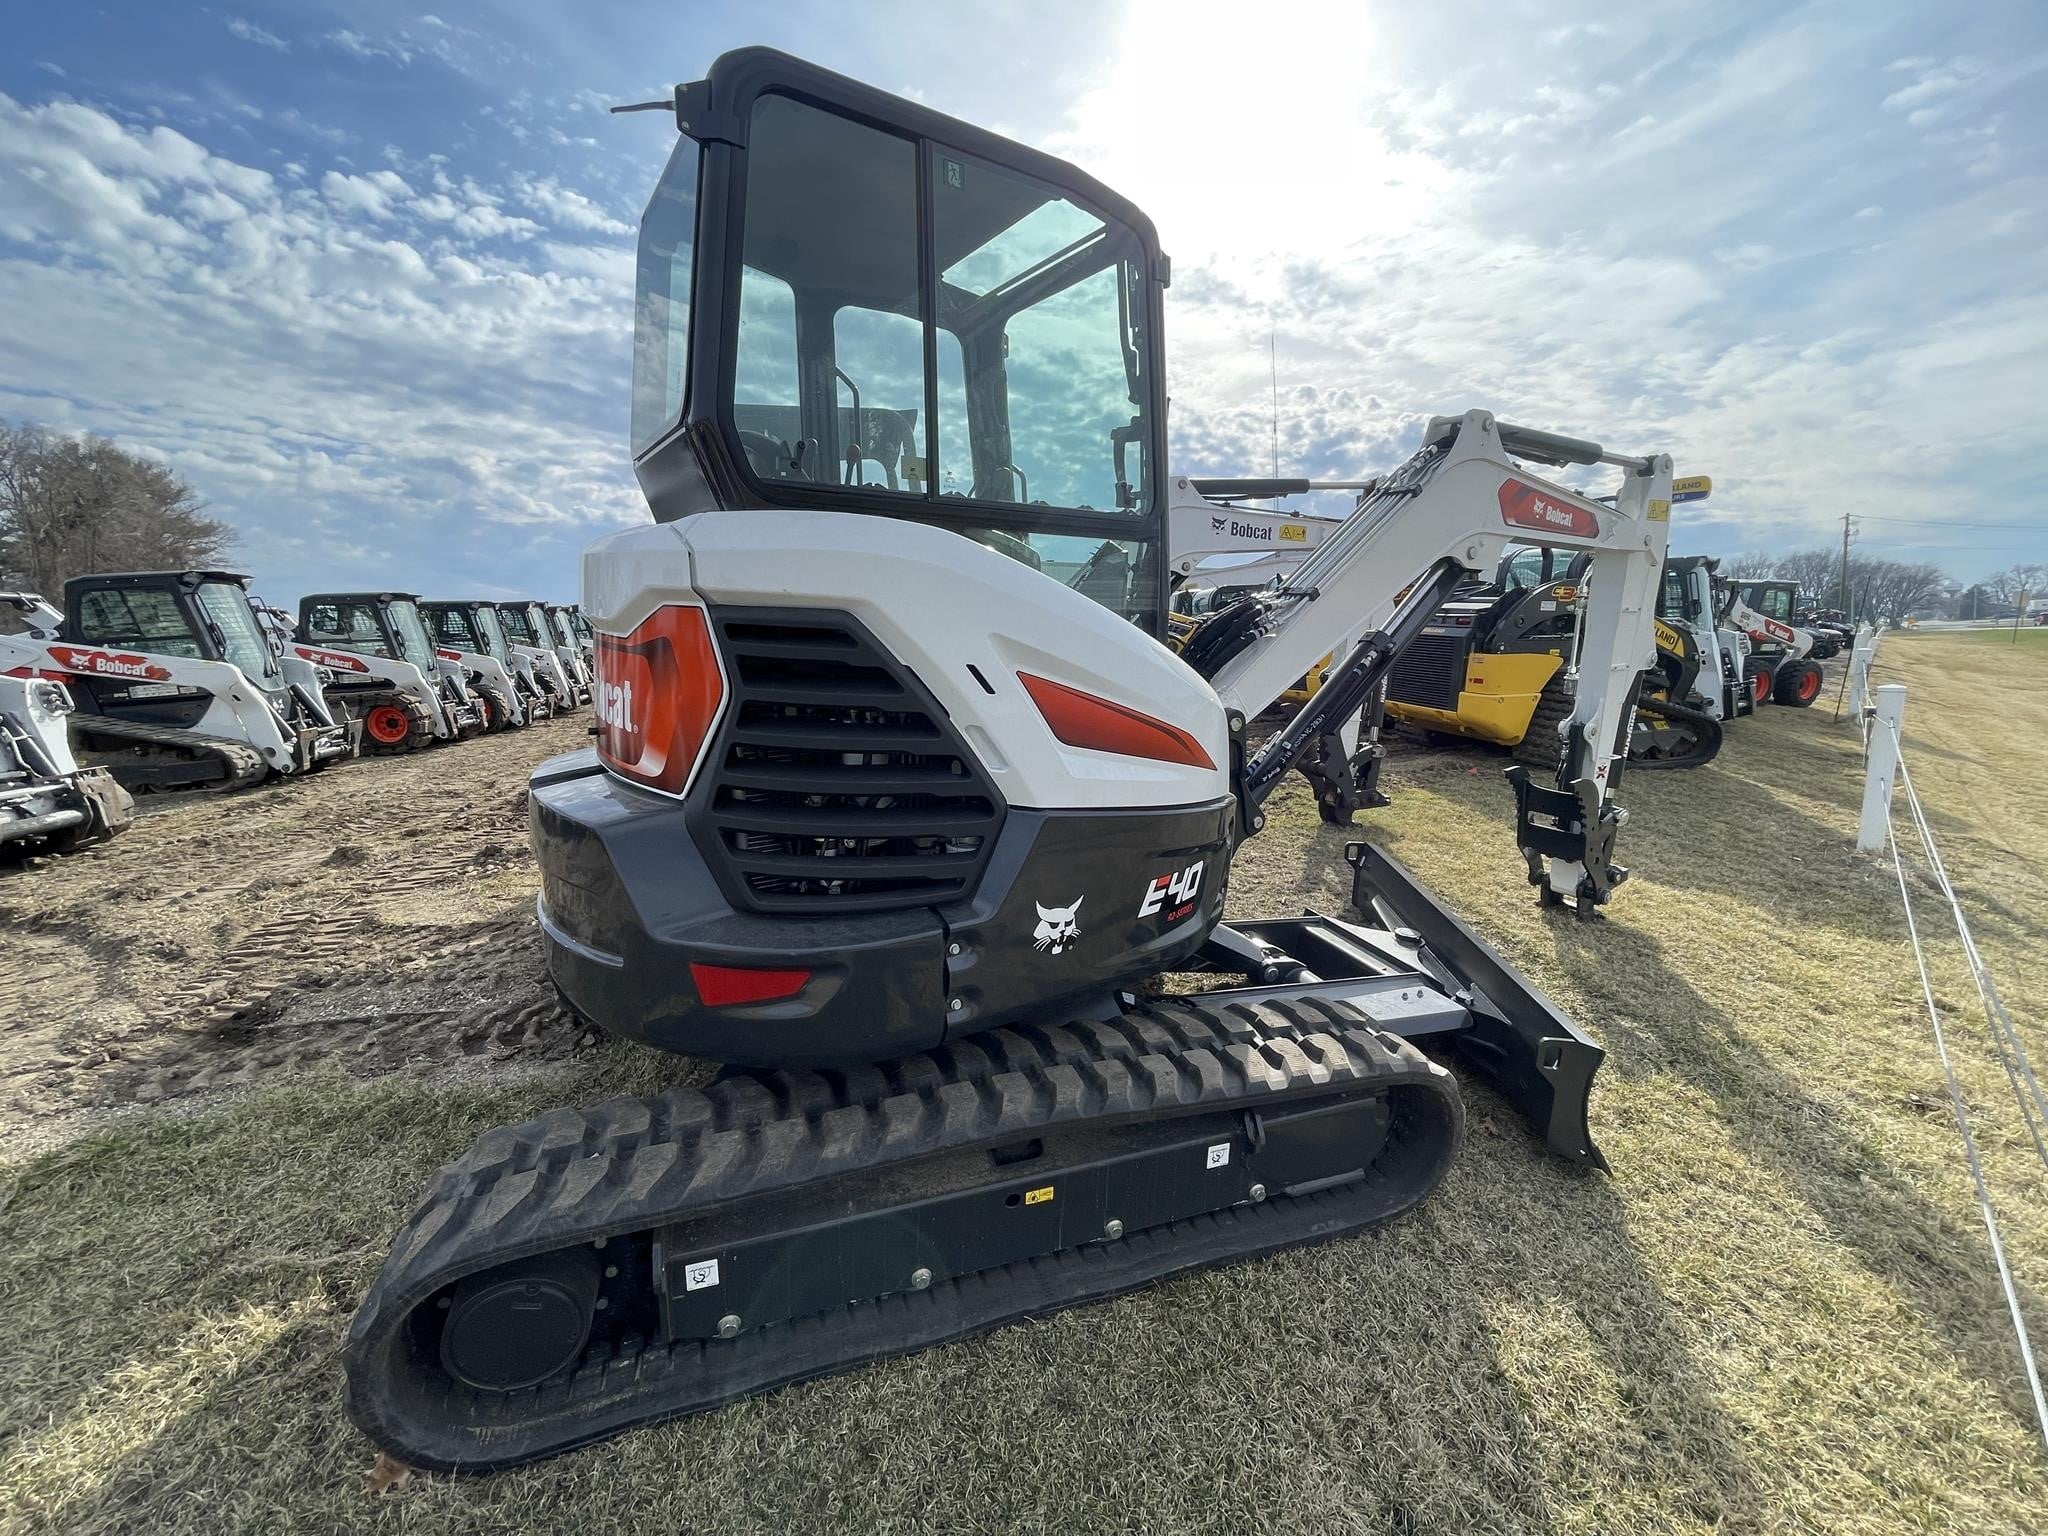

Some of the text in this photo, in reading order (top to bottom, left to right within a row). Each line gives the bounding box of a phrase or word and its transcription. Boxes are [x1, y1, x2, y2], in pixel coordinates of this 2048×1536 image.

[1546, 506, 1573, 527] Bobcat
[1231, 521, 1272, 540] Bobcat
[96, 658, 147, 676] Bobcat
[324, 656, 353, 668] Bobcat
